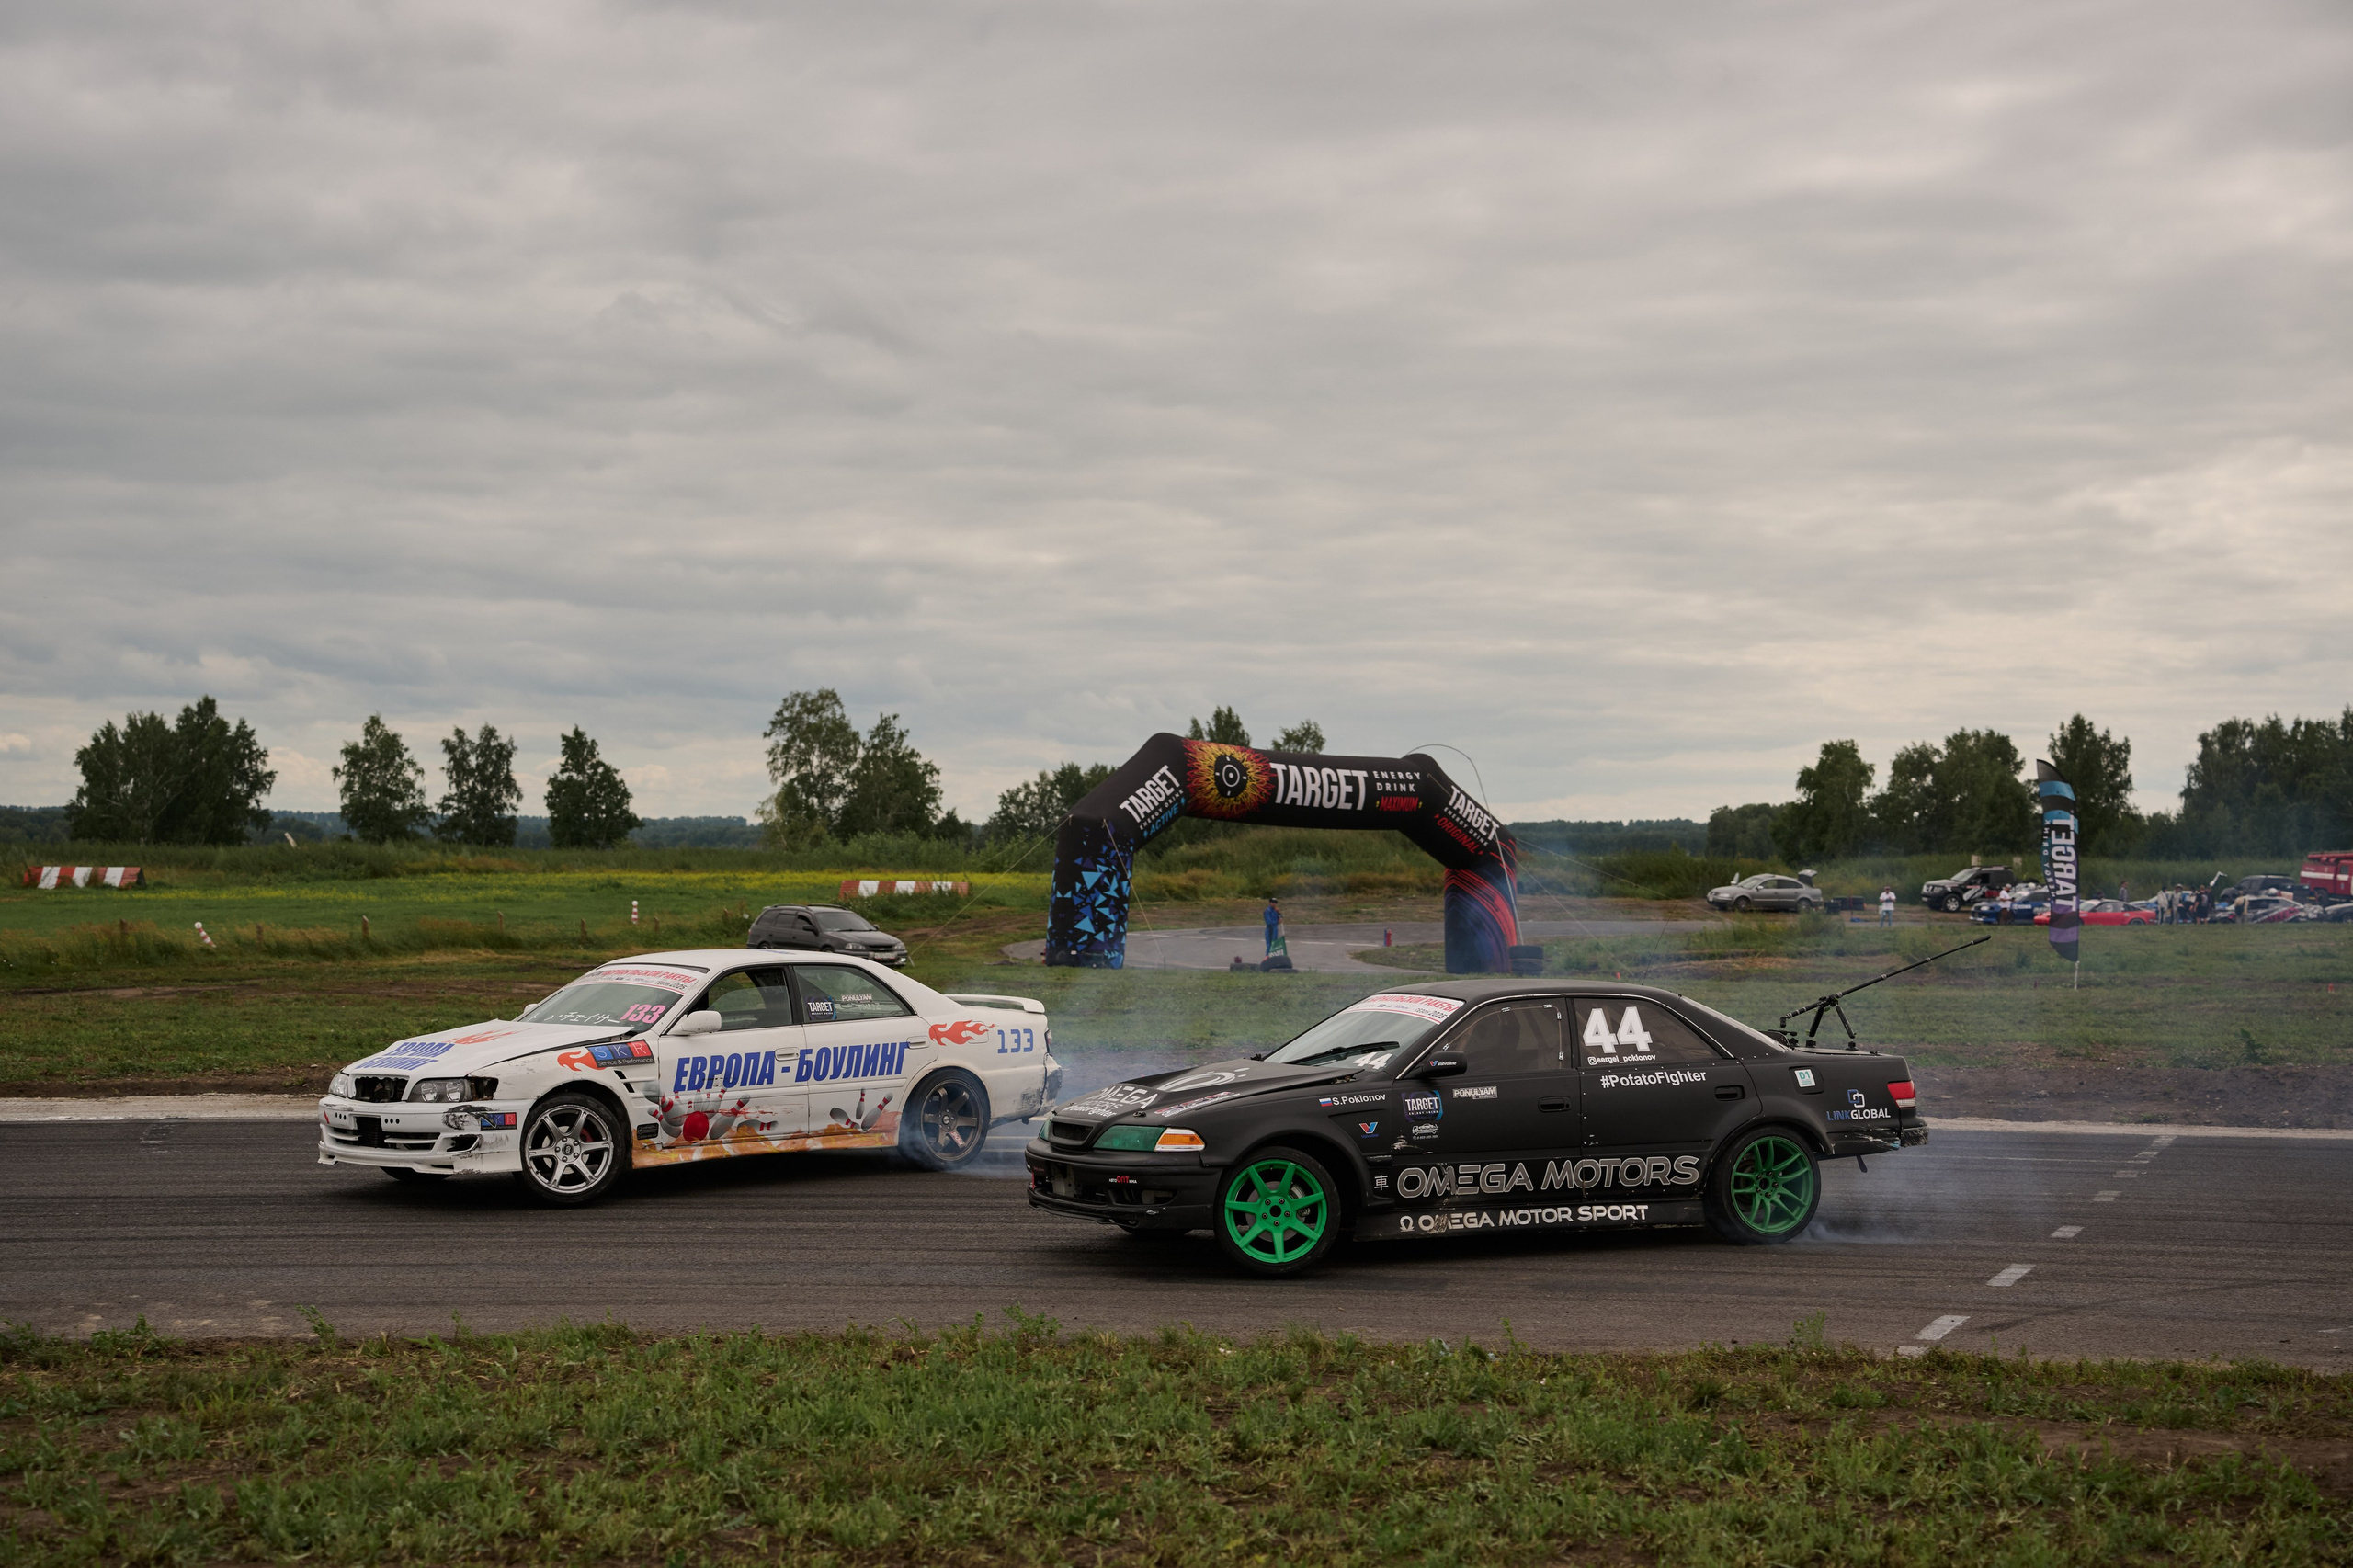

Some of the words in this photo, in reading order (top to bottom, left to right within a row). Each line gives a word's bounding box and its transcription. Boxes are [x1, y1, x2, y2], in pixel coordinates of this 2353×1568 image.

[1372, 770, 1421, 780] ENERGY
[1119, 765, 1180, 823] TARGET
[1269, 762, 1368, 811] TARGET
[1376, 782, 1416, 792] DRINK
[1140, 808, 1163, 830] ENERGY
[1165, 790, 1184, 808] DRINK
[1379, 796, 1419, 812] MAXIMUM
[1449, 785, 1500, 841] TARGET
[1150, 802, 1178, 835] ACTIVE
[1443, 806, 1469, 829] ENERGY
[1469, 828, 1489, 847] DRINK
[1437, 816, 1480, 854] ORIGINAL
[669, 982, 687, 990] 2025
[620, 1003, 666, 1024] 133
[807, 1002, 833, 1012] TARGET
[1421, 998, 1460, 1012] РАКЕТЫ
[1428, 1010, 1448, 1019] 2025
[1582, 1006, 1654, 1054] 44
[382, 1042, 455, 1057] ЕВРОПА
[594, 1041, 647, 1058] SKR
[997, 1028, 1034, 1053] 133
[673, 1051, 775, 1092] ЕВРОПА
[795, 1042, 910, 1082] БОУЛИНГ
[1353, 1051, 1392, 1070] 44
[1600, 1069, 1707, 1089] #PotatoFighter
[1799, 1071, 1811, 1079] D1
[1332, 1093, 1386, 1106] S.Poklonov
[1454, 1086, 1496, 1097] PONULYAM
[1404, 1096, 1438, 1111] TARGET
[1374, 1174, 1389, 1191] 車
[1397, 1162, 1534, 1198] OMEGA
[1540, 1155, 1700, 1190] MOTORS
[1498, 1206, 1574, 1226] MOTOR
[1577, 1204, 1649, 1221] SPORT
